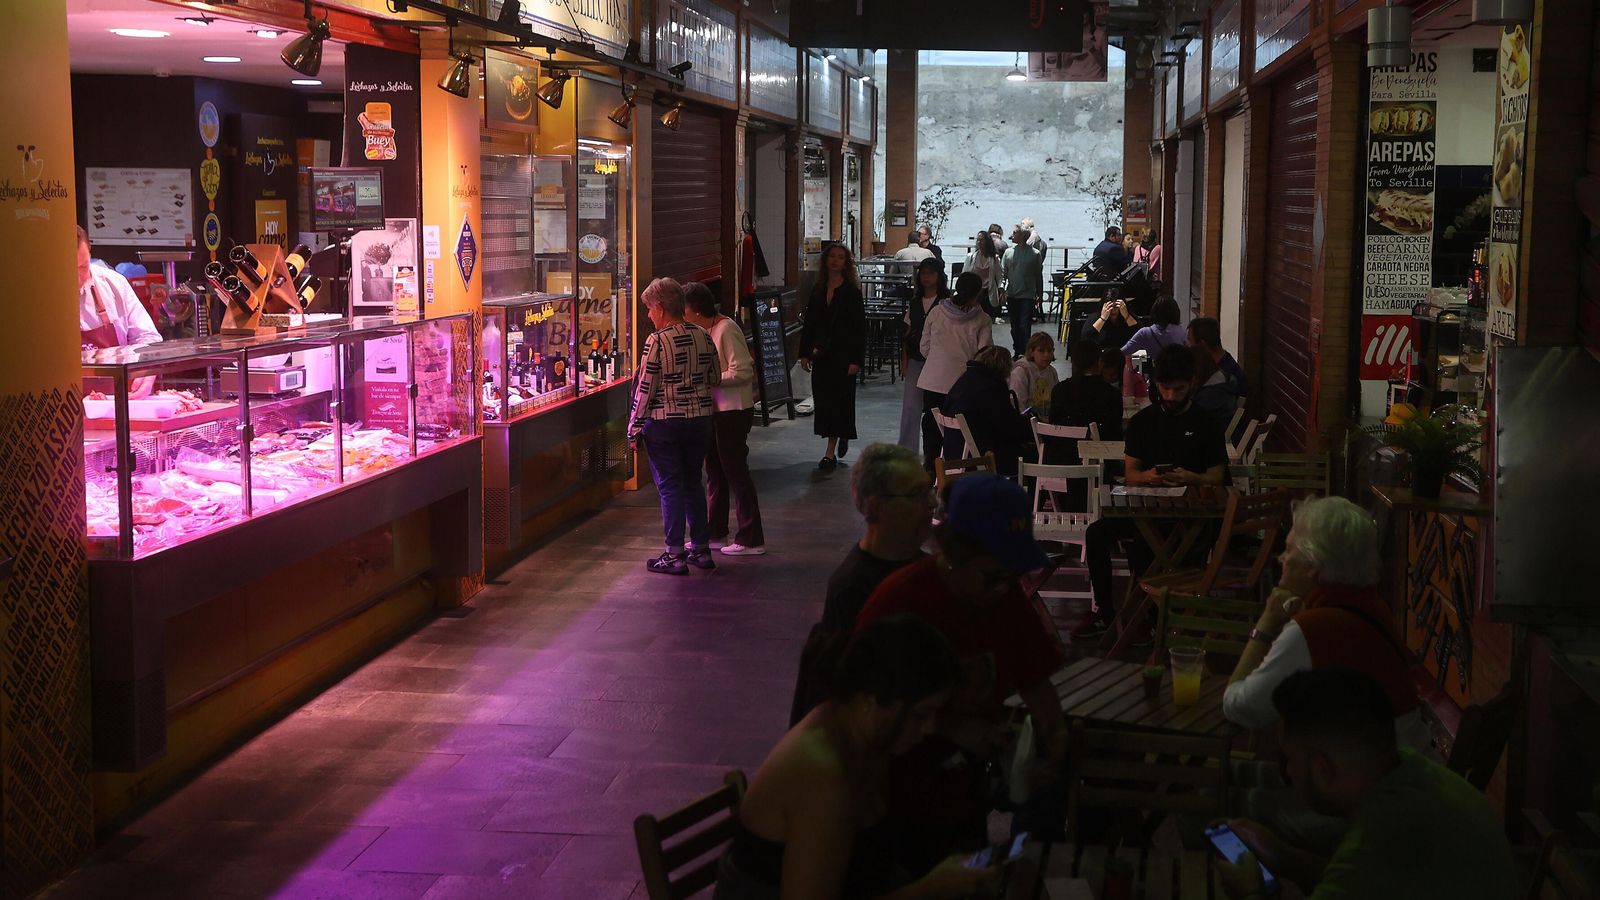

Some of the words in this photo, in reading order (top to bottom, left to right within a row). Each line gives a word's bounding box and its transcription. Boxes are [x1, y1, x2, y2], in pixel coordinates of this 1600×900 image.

[1373, 52, 1437, 73] PAS
[1386, 72, 1437, 91] Venezuela
[1371, 91, 1393, 99] Para
[1399, 91, 1437, 99] Sevilla
[368, 134, 390, 147] Buey
[1370, 141, 1435, 162] AREPAS
[1370, 165, 1390, 177] From
[1392, 161, 1434, 178] Venezuela
[1369, 178, 1382, 188] To
[1389, 177, 1433, 188] Seville
[265, 221, 279, 235] HOY
[1367, 245, 1386, 253] BEEF
[1386, 244, 1430, 254] CARNE
[1367, 254, 1430, 262] VEGETARIANA
[1366, 262, 1402, 272] CARAOTA
[1403, 262, 1430, 272] NEGRA
[1366, 274, 1430, 286] CHEESE
[1366, 285, 1390, 299] QUESO
[1366, 300, 1390, 310] HAM
[1390, 299, 1426, 310] AGUAC
[548, 322, 612, 349] Bey
[35, 387, 62, 444] LECHAZO
[44, 388, 81, 469] ASADO
[49, 446, 78, 508] ASADO
[25, 550, 53, 609] ASADO
[58, 475, 84, 531] HORNO
[54, 512, 85, 579] PROPIA
